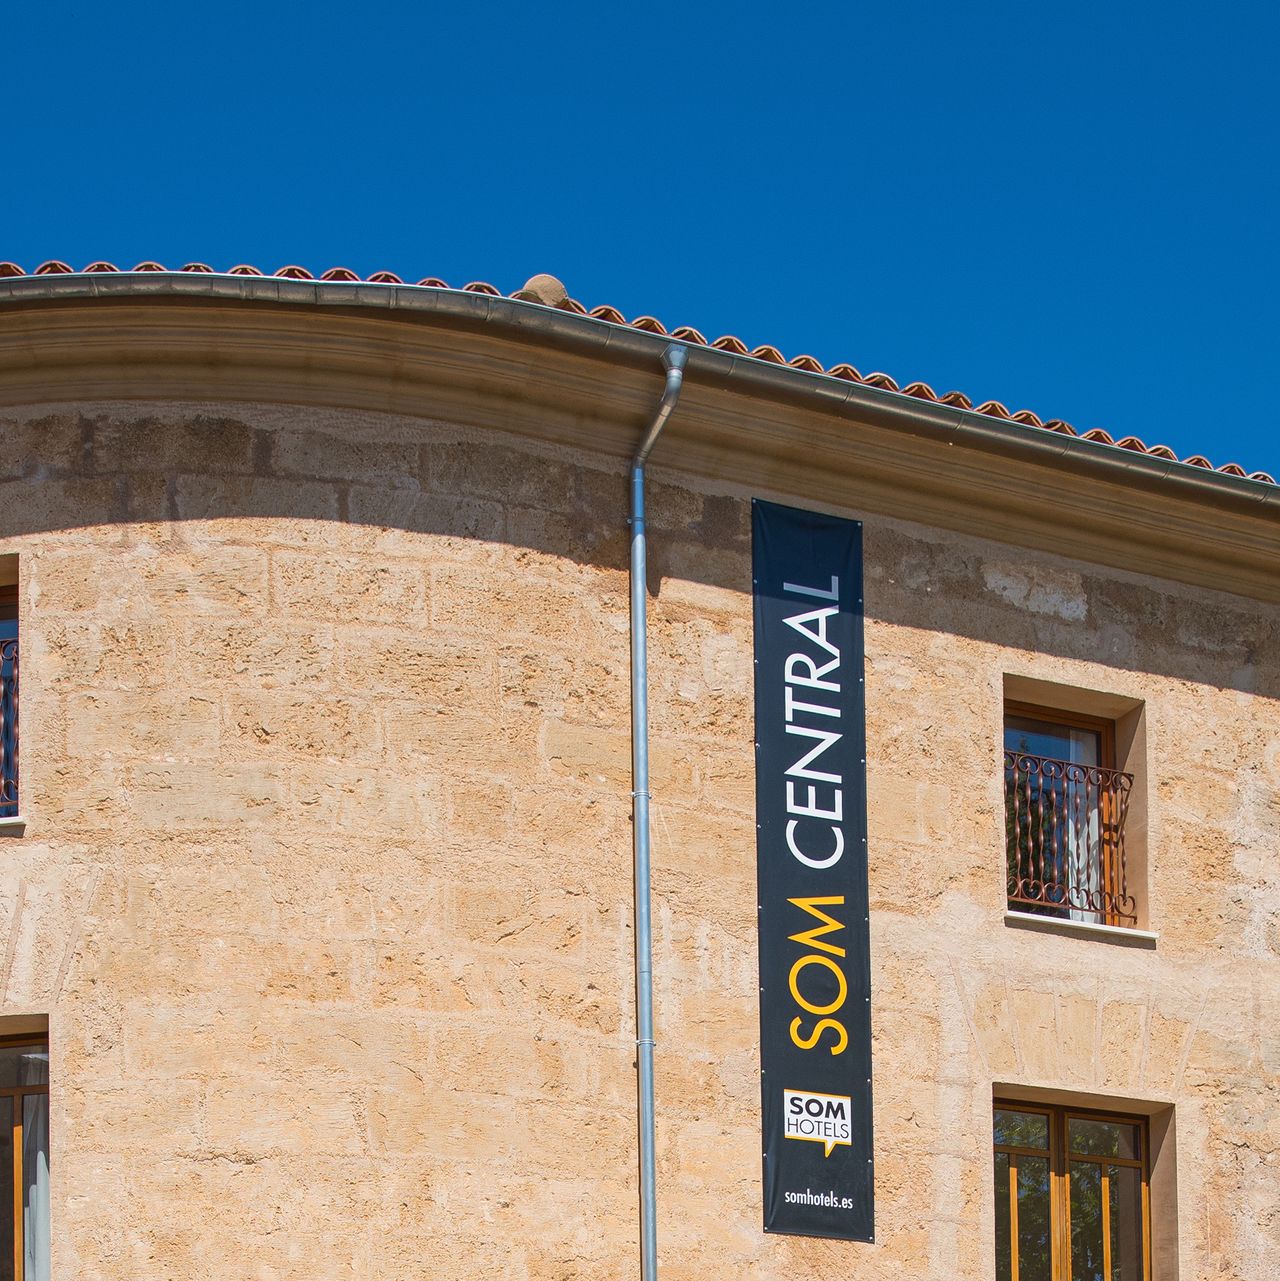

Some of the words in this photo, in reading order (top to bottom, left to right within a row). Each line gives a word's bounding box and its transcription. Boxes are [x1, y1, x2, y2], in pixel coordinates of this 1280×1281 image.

[782, 575, 845, 870] CENTRAL
[786, 895, 849, 1056] SOM
[789, 1096, 846, 1120] SOM
[787, 1117, 850, 1139] HOTELS
[784, 1188, 854, 1209] somhotels.es
